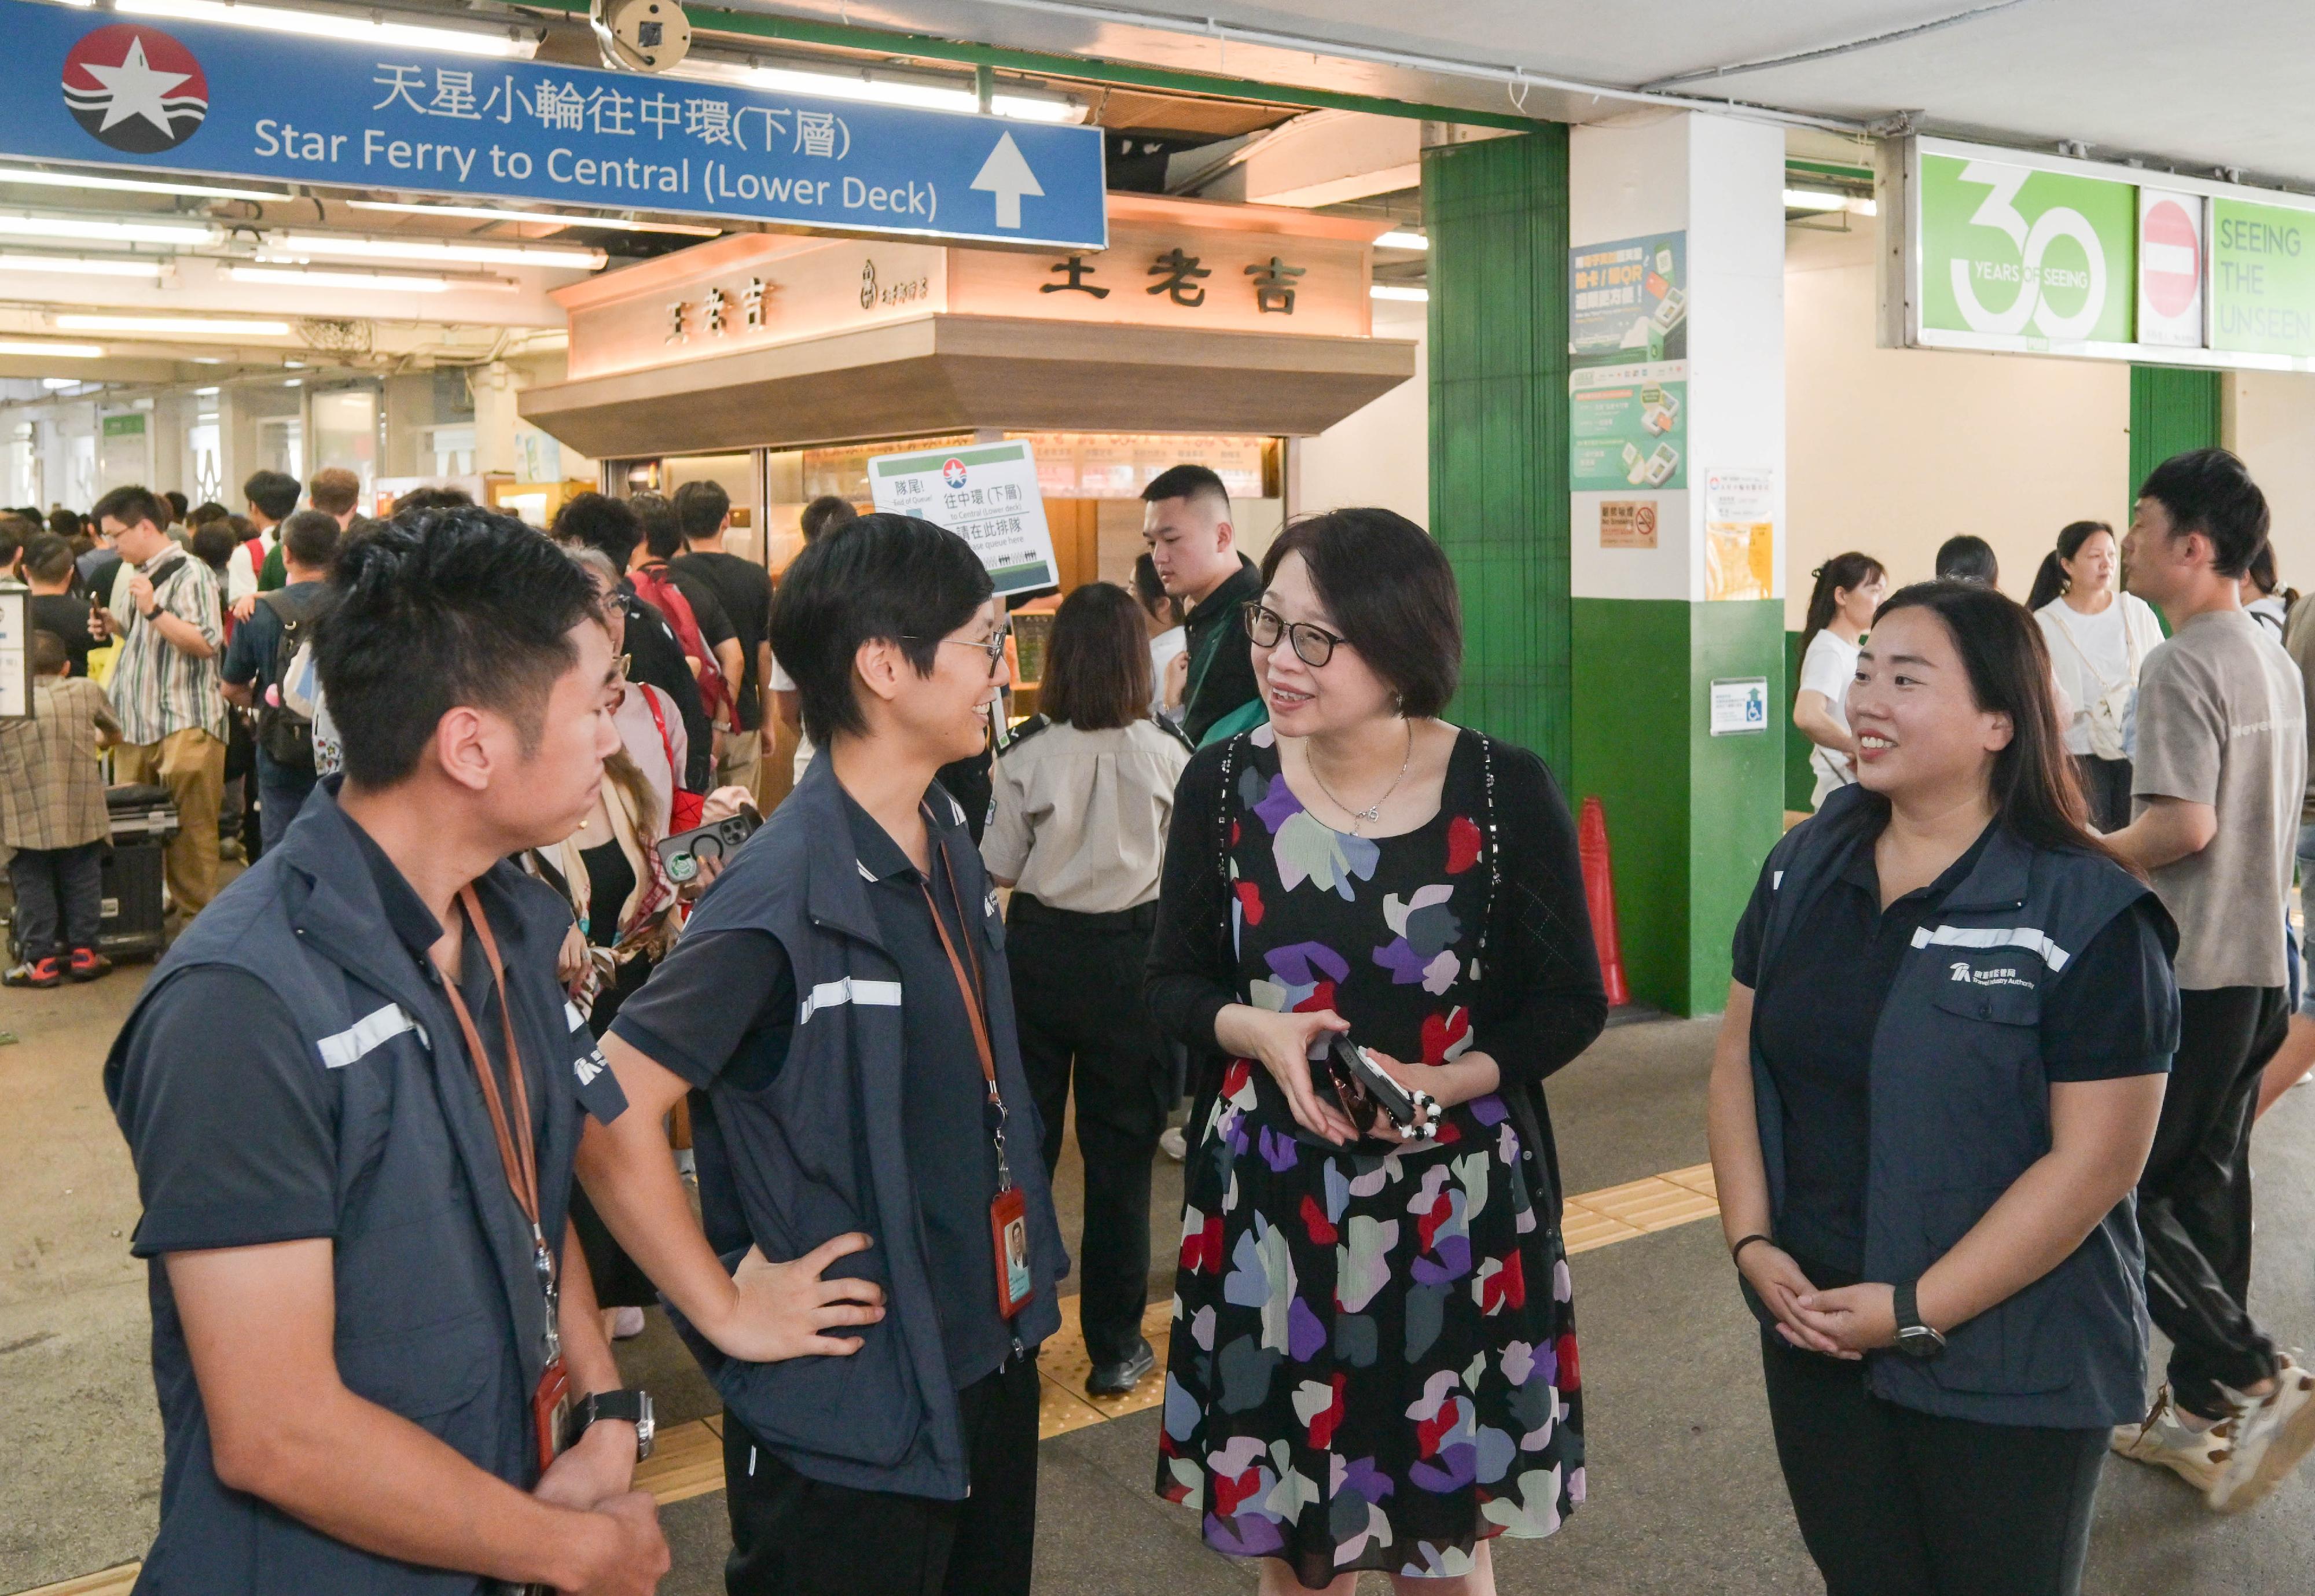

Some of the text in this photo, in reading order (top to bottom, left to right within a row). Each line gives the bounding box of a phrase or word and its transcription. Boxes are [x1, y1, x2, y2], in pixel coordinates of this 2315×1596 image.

[372, 62, 851, 161] 天星小輪往中環(下層)
[255, 119, 938, 223] Star Ferry to Central (Lower Deck)
[2221, 218, 2302, 257] SEEING
[1975, 260, 2088, 289] YEARS OF SEEING
[2221, 261, 2264, 295] THE
[666, 277, 766, 345] 王老吉
[2221, 303, 2311, 340] UNSEEN
[895, 479, 925, 495] 隊尾!
[944, 484, 1022, 509] 往中環 (下層)
[958, 509, 982, 519] Central
[983, 507, 1004, 516] (Lower
[1005, 503, 1022, 513] deck)
[956, 517, 1023, 540] 請在此排隊
[985, 539, 1007, 550] queue
[1009, 536, 1024, 545] here
[1972, 977, 1989, 986] Travel
[2008, 978, 2035, 990] Authority
